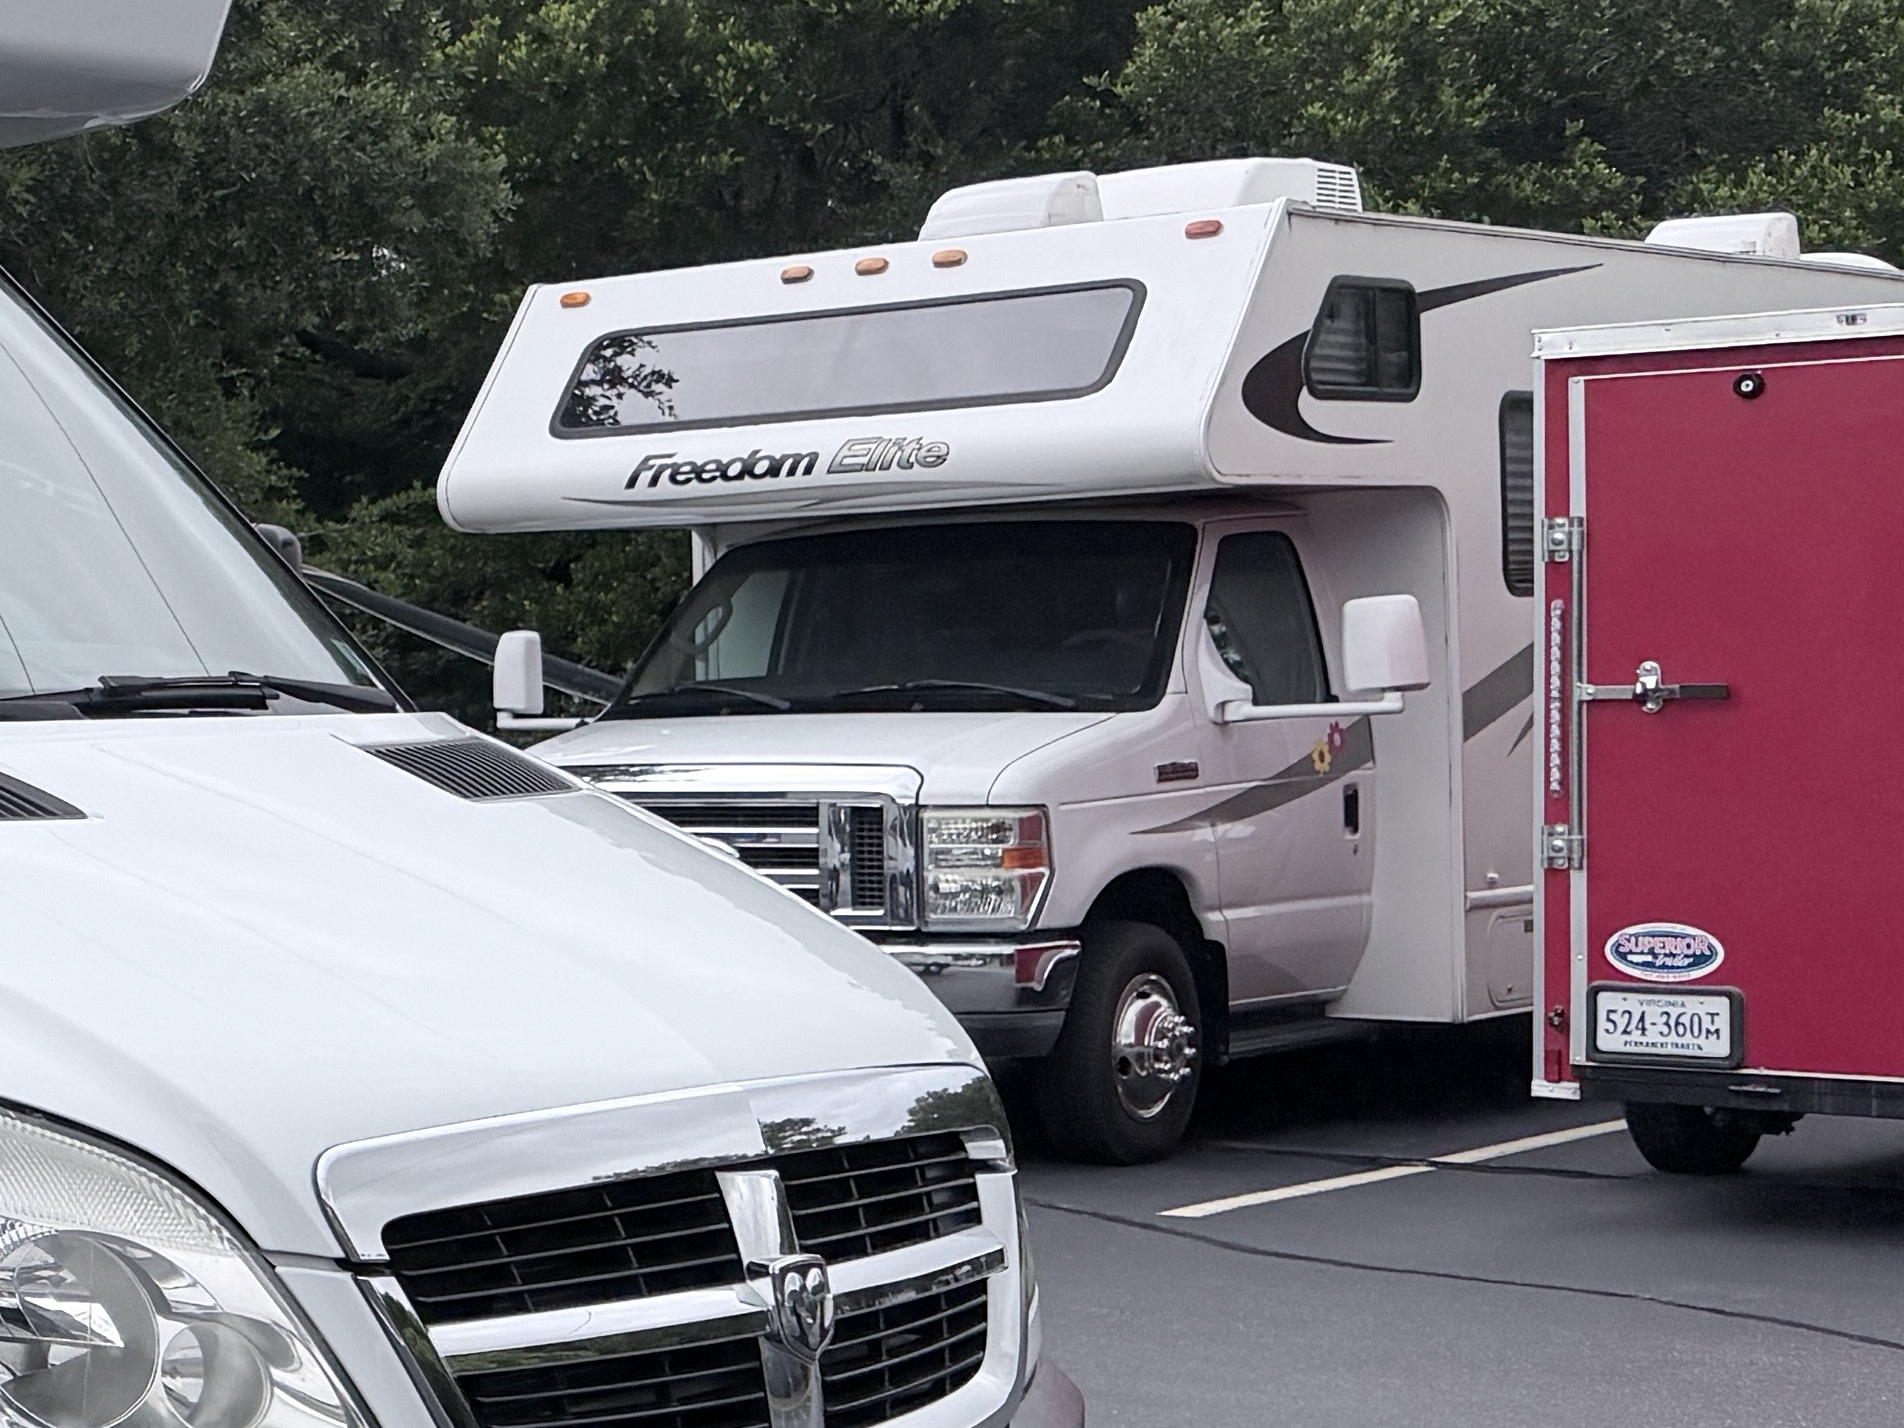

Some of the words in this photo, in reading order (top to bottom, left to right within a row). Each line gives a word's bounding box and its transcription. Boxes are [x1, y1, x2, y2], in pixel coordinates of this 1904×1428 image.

[624, 449, 820, 491] Freedom
[826, 436, 950, 475] Elite
[1616, 932, 1712, 956] SUPERIOR
[1638, 998, 1688, 1009] VIRGINIA
[1603, 1008, 1702, 1040] 524-360
